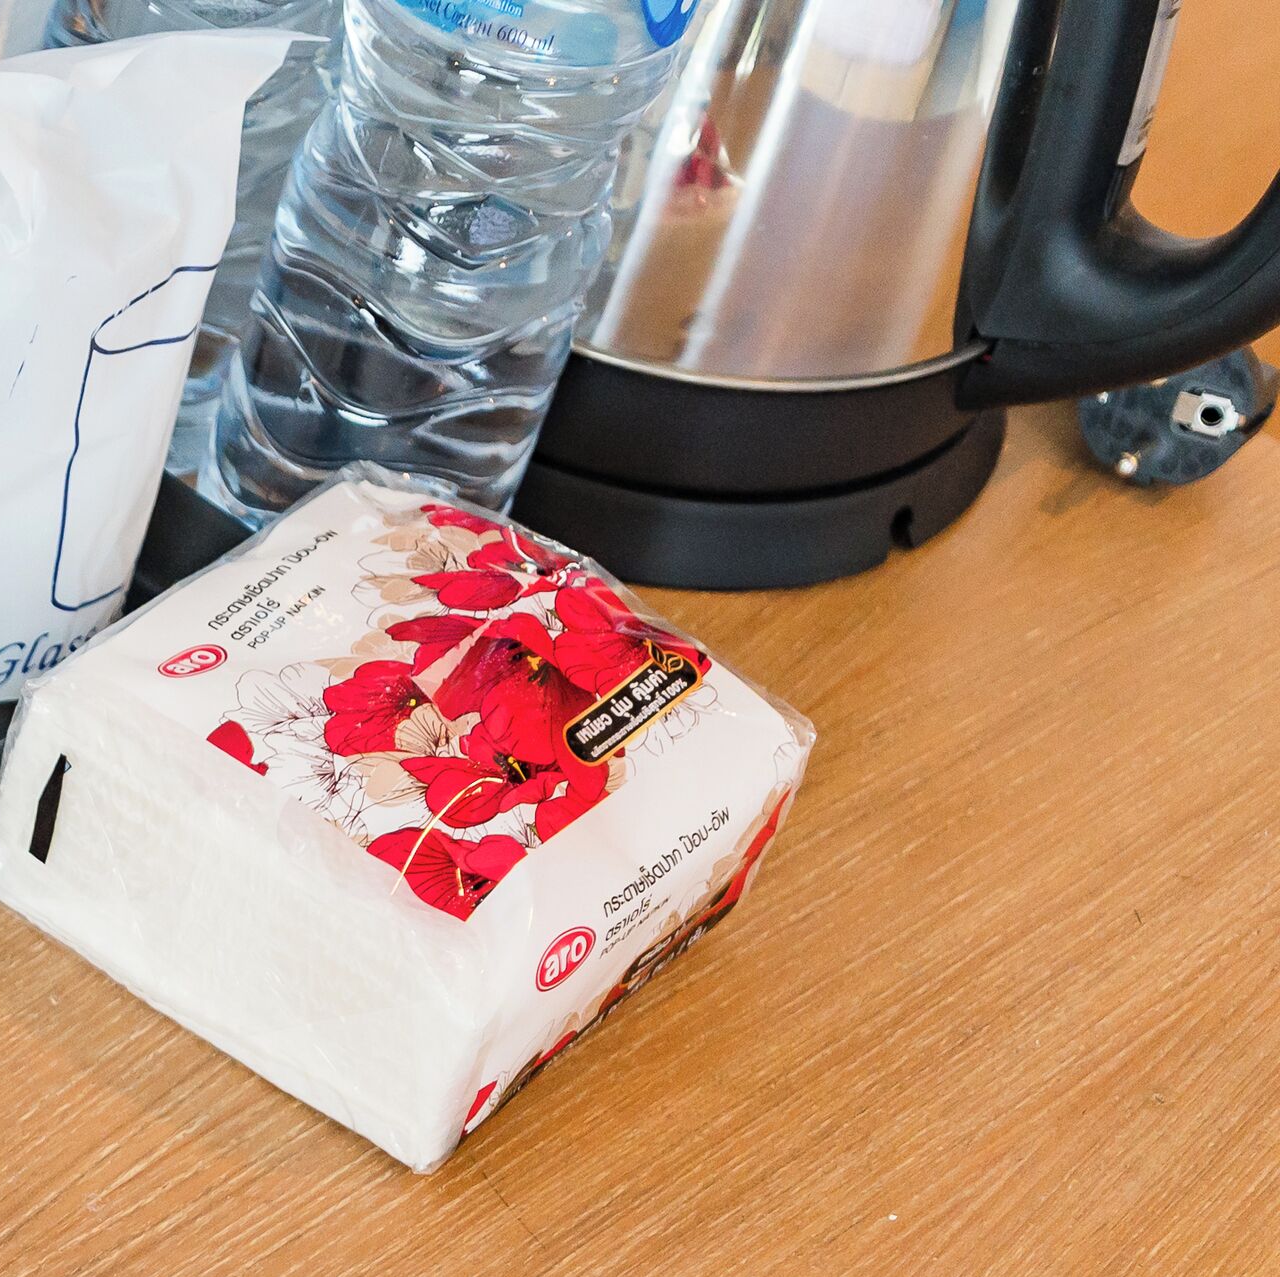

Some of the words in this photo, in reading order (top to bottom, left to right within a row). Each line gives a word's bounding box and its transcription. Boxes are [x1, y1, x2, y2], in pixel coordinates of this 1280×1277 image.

[496, 23, 529, 49] 600
[246, 615, 288, 651] POP-UP
[165, 649, 219, 675] aro
[661, 677, 689, 701] 100%
[543, 934, 588, 985] aro
